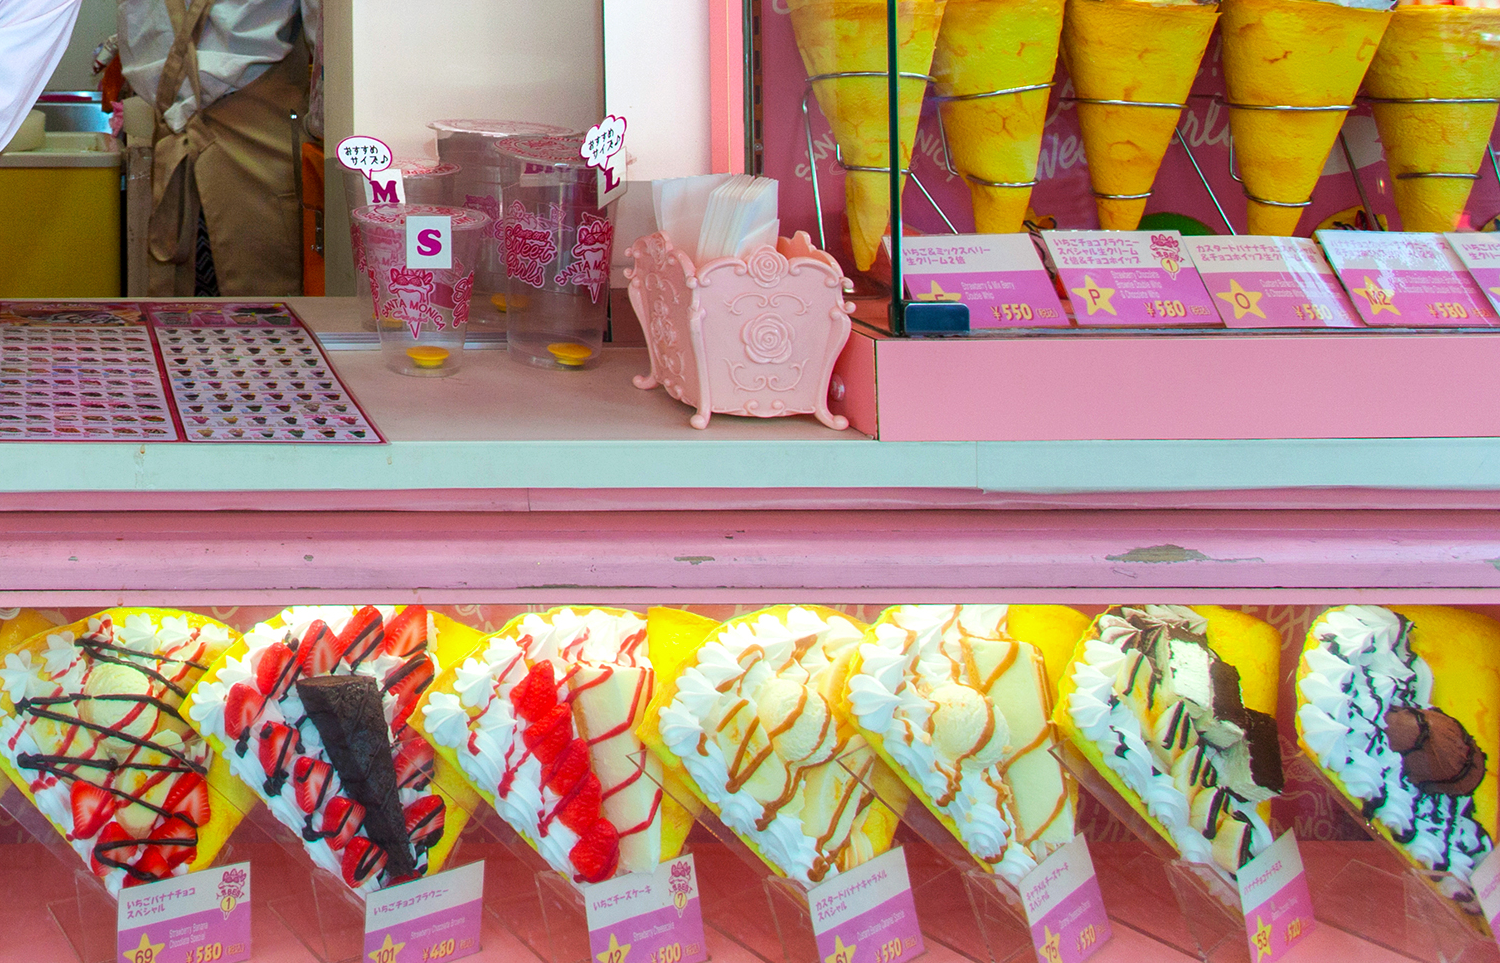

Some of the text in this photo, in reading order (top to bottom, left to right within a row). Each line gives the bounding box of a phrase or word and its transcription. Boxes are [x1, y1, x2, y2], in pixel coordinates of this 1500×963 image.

[588, 128, 615, 150] おすすめ
[344, 145, 378, 156] おすすめ
[604, 167, 621, 194] L
[370, 180, 400, 203] M
[417, 229, 442, 256] S
[505, 226, 555, 263] Sweet
[903, 246, 991, 257] いちご&ミックスベリー
[1053, 238, 1140, 247] いちごチョコブラウニー
[1058, 247, 1138, 256] スペシャル生クリーム
[506, 251, 544, 287] Girls
[906, 256, 966, 266] 生クリーム2倍
[1063, 255, 1141, 265] 2倍&チョコホイップ
[555, 263, 589, 285] SANTA
[1088, 289, 1100, 306] P
[1235, 292, 1251, 309] O
[1364, 291, 1391, 306] M2
[382, 298, 446, 330] SANTA MONICA
[990, 303, 1034, 321] ¥550
[1144, 300, 1187, 317] ¥580
[1426, 302, 1469, 318] ¥580
[816, 869, 887, 911] カスタードバナナキャラメル
[1026, 862, 1068, 901] キャラメルチーズケーキ
[127, 887, 196, 909] いちごバナナチョコ
[374, 889, 449, 915] いちごチョコブラウニー
[593, 885, 651, 911] いちごチーズケーキ
[127, 903, 165, 919] スペシャル
[817, 901, 847, 921] スペシャル
[193, 922, 208, 933] Banana
[422, 938, 455, 962] ¥480
[874, 937, 903, 963] ¥550
[1257, 930, 1268, 951] 53
[135, 948, 153, 963] 69
[185, 942, 223, 963] ¥580
[376, 947, 395, 963] 101
[650, 942, 682, 963] ¥500
[1045, 940, 1057, 963] 75
